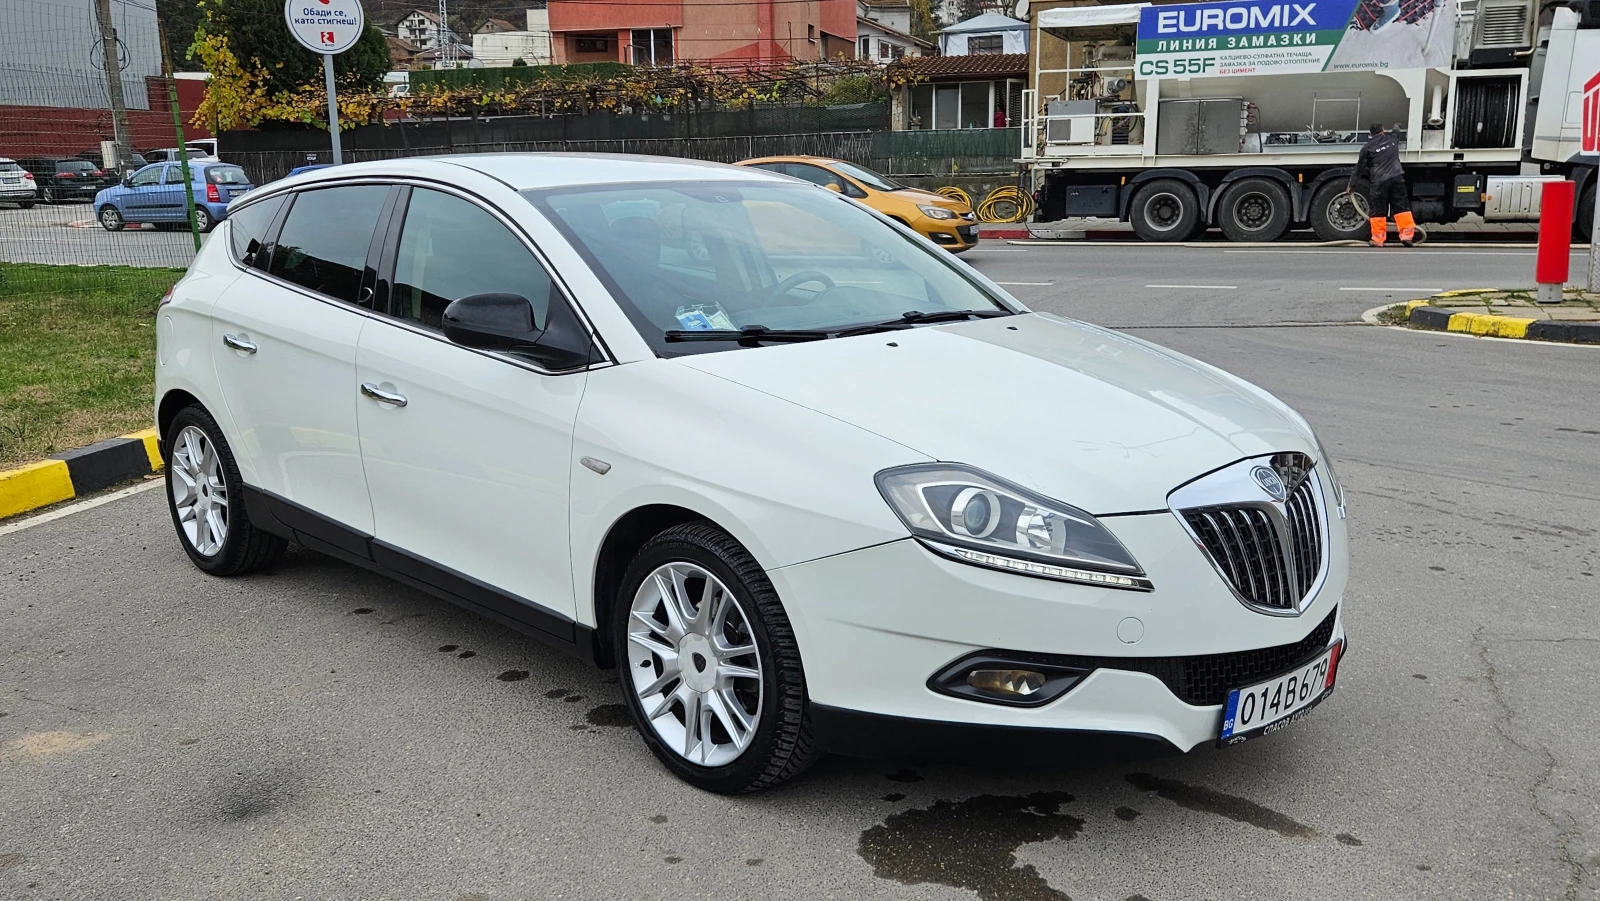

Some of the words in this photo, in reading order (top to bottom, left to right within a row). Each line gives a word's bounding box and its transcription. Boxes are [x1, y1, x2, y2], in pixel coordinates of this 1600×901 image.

[303, 8, 332, 17] Обади
[1157, 2, 1317, 34] EUROMIX
[317, 17, 357, 25] стигнеш!
[1157, 38, 1217, 52] ЛИНИЯ
[1227, 33, 1317, 48] ЗАМАЗКИ
[1220, 52, 1285, 61] КАЛЦИЕВО-СУЛФАТНА
[1140, 59, 1169, 76] CS
[1173, 57, 1216, 75] 55F
[1333, 61, 1389, 69] www.euromix.bg
[1231, 67, 1256, 75] ЦИМЕНТ
[1240, 657, 1328, 726] 014B679
[1223, 718, 1234, 731] BG
